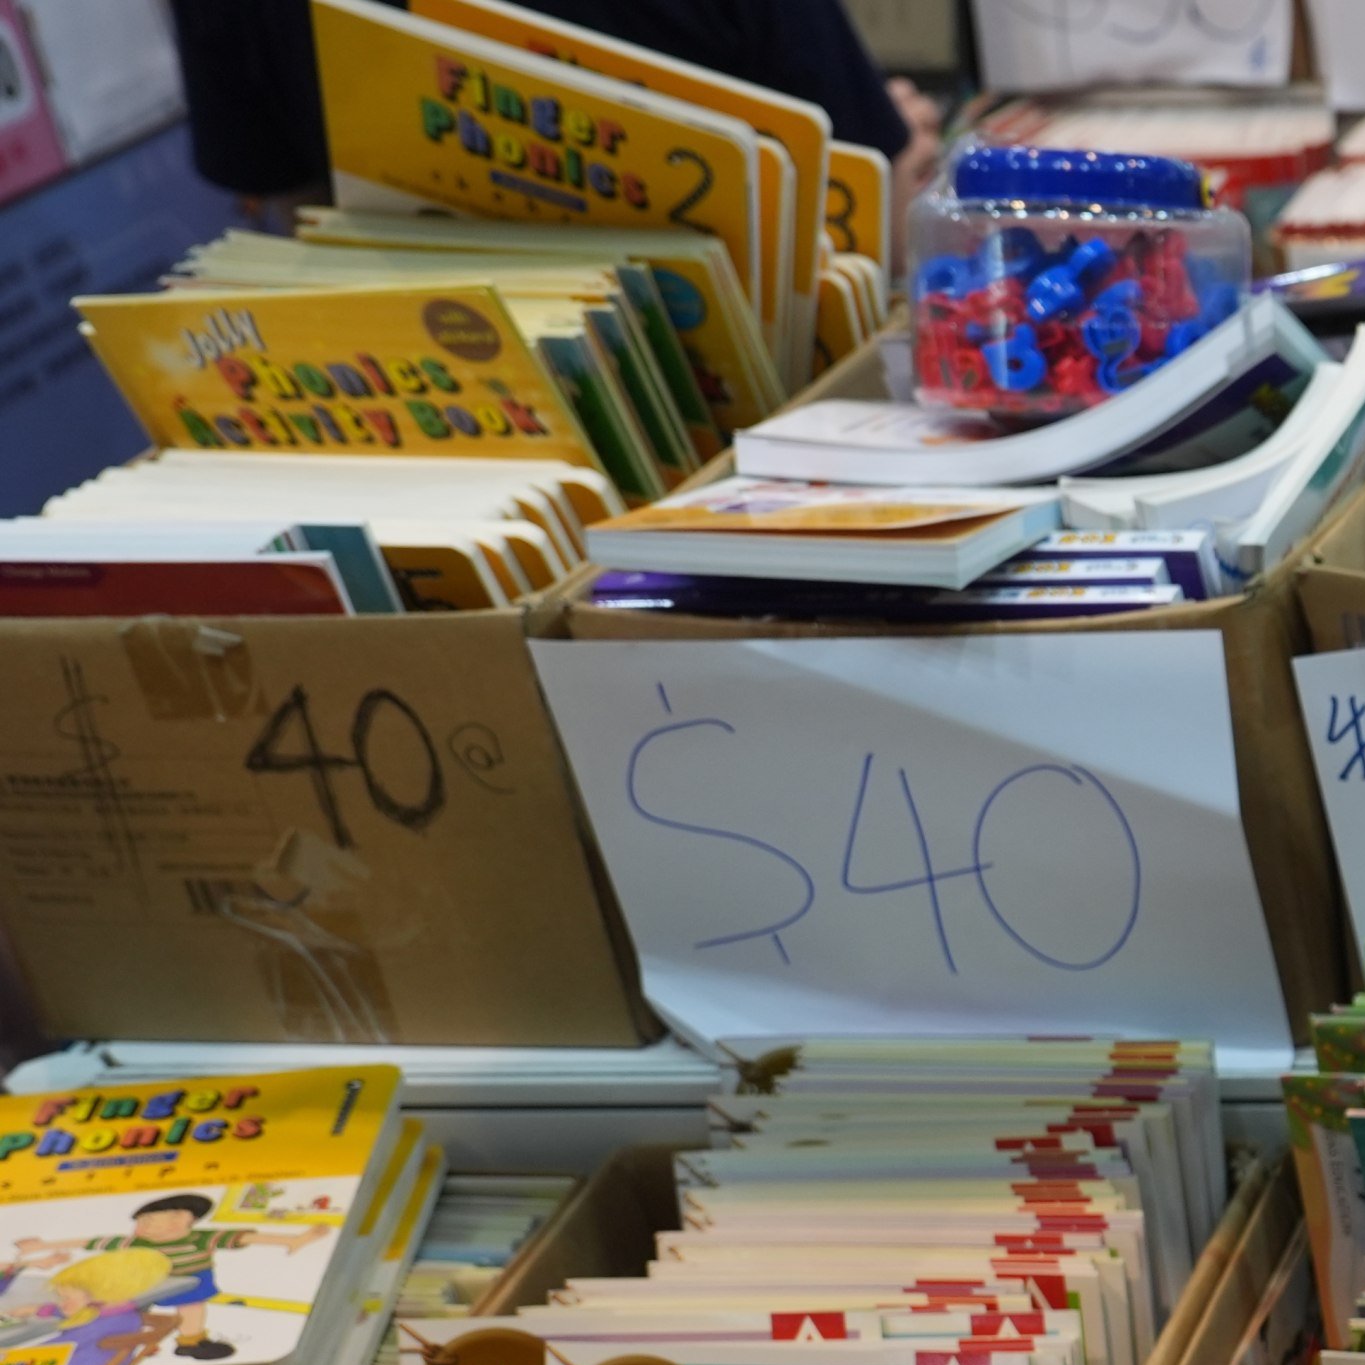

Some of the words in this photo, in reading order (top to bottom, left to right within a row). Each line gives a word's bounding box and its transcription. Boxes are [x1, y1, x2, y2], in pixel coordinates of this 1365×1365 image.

[434, 54, 627, 154] Finger
[421, 97, 650, 210] Phonics
[665, 146, 718, 234] 2
[180, 306, 268, 370] Jolly
[214, 352, 463, 402] Phonics
[177, 402, 402, 450] Activity
[406, 398, 550, 442] Book
[627, 682, 1141, 976] $40
[32, 1085, 261, 1126] Finger
[0, 1116, 266, 1160] Phonics
